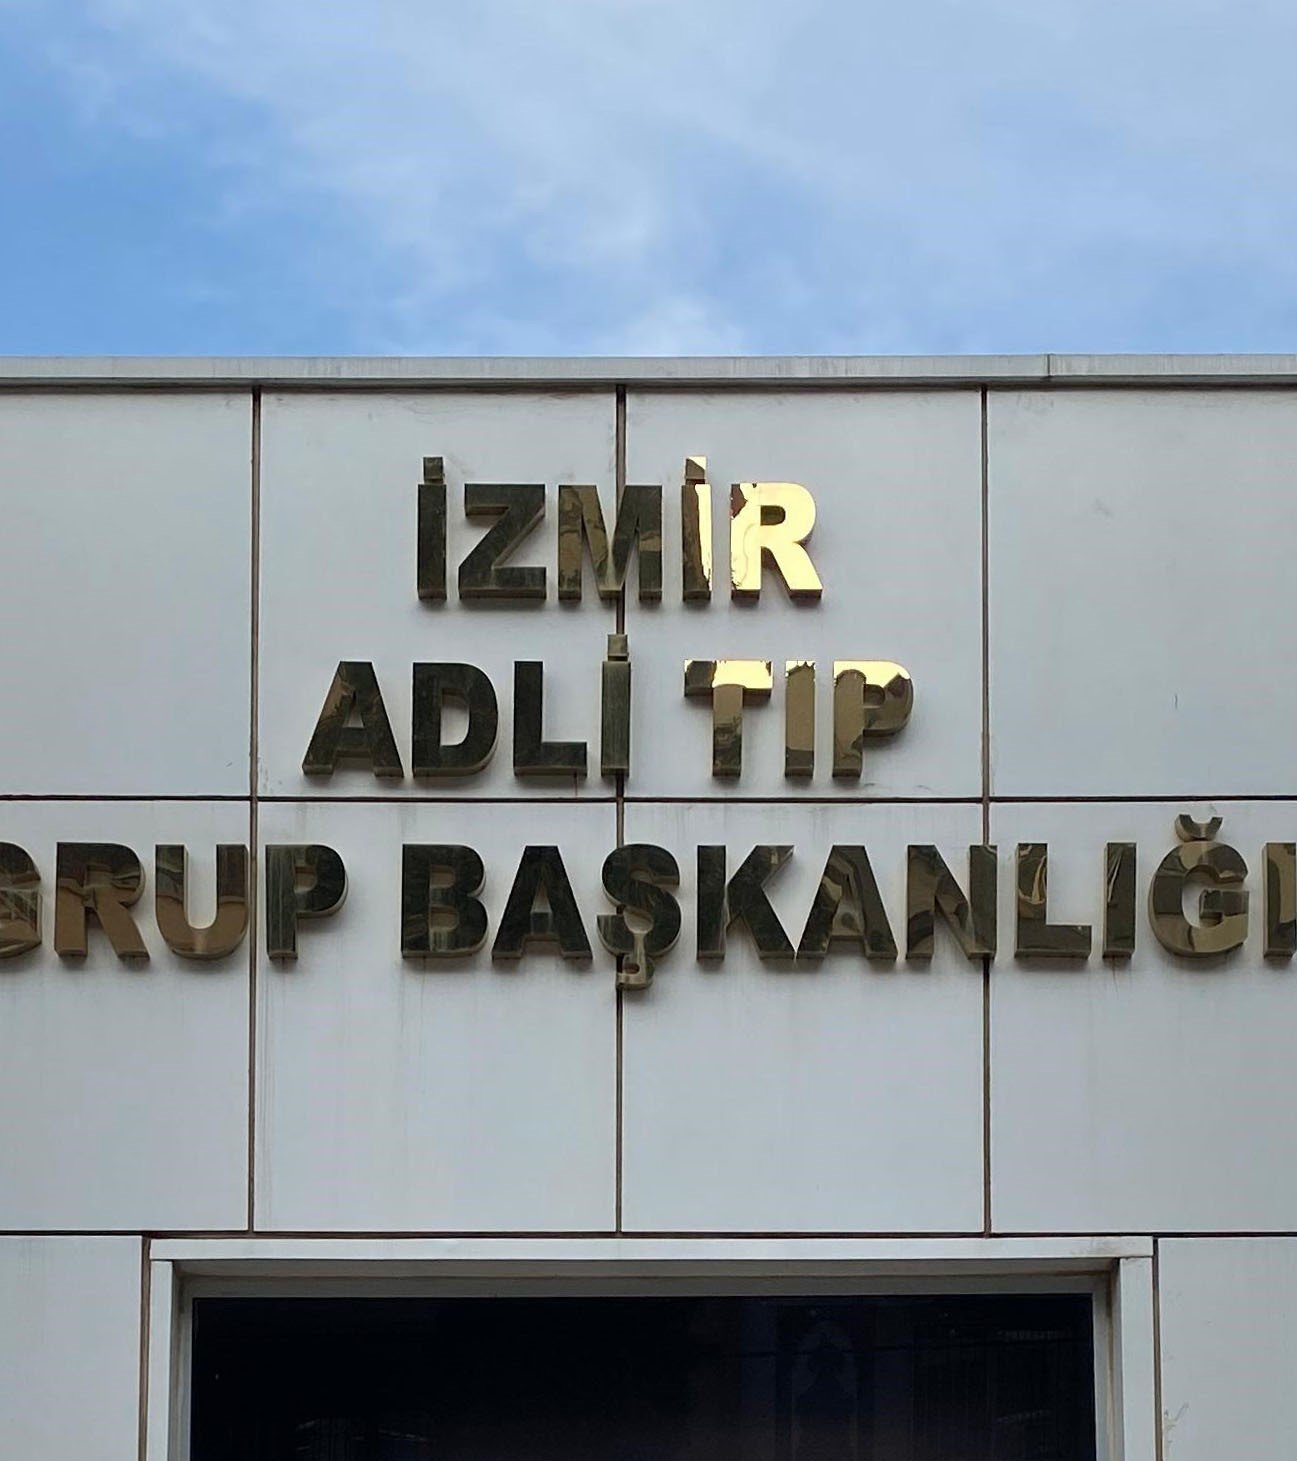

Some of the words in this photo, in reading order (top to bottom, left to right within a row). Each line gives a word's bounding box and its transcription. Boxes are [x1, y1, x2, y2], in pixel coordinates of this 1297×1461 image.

[415, 456, 823, 604] İZMİR
[301, 634, 632, 779] ADLİ
[683, 659, 914, 780] TIP
